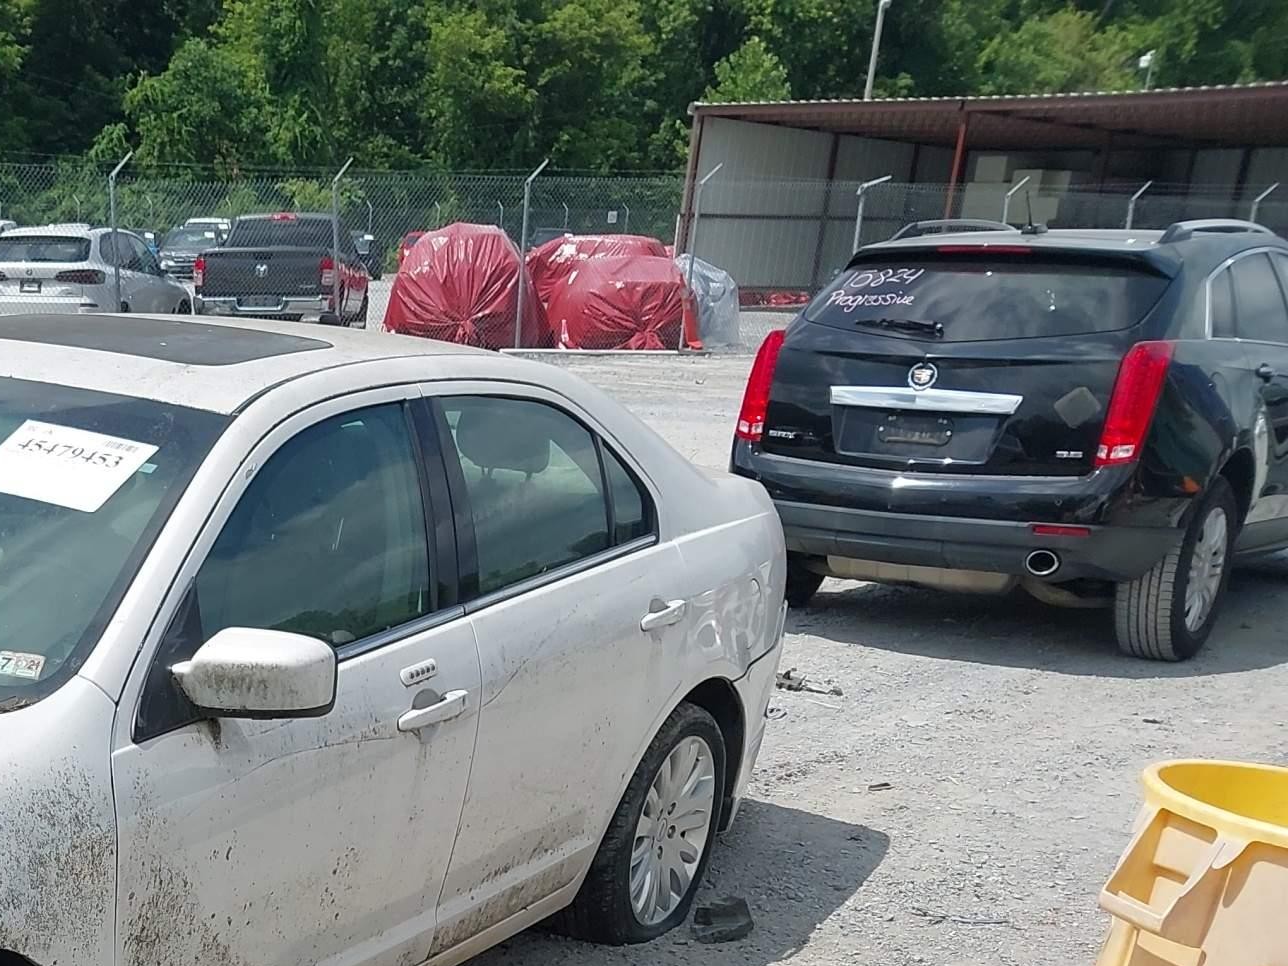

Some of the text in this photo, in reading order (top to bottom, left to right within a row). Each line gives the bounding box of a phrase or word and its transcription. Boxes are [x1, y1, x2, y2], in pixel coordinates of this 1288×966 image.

[827, 289, 914, 312] Progressive
[17, 438, 124, 468] 45479453
[1, 656, 13, 671] 7
